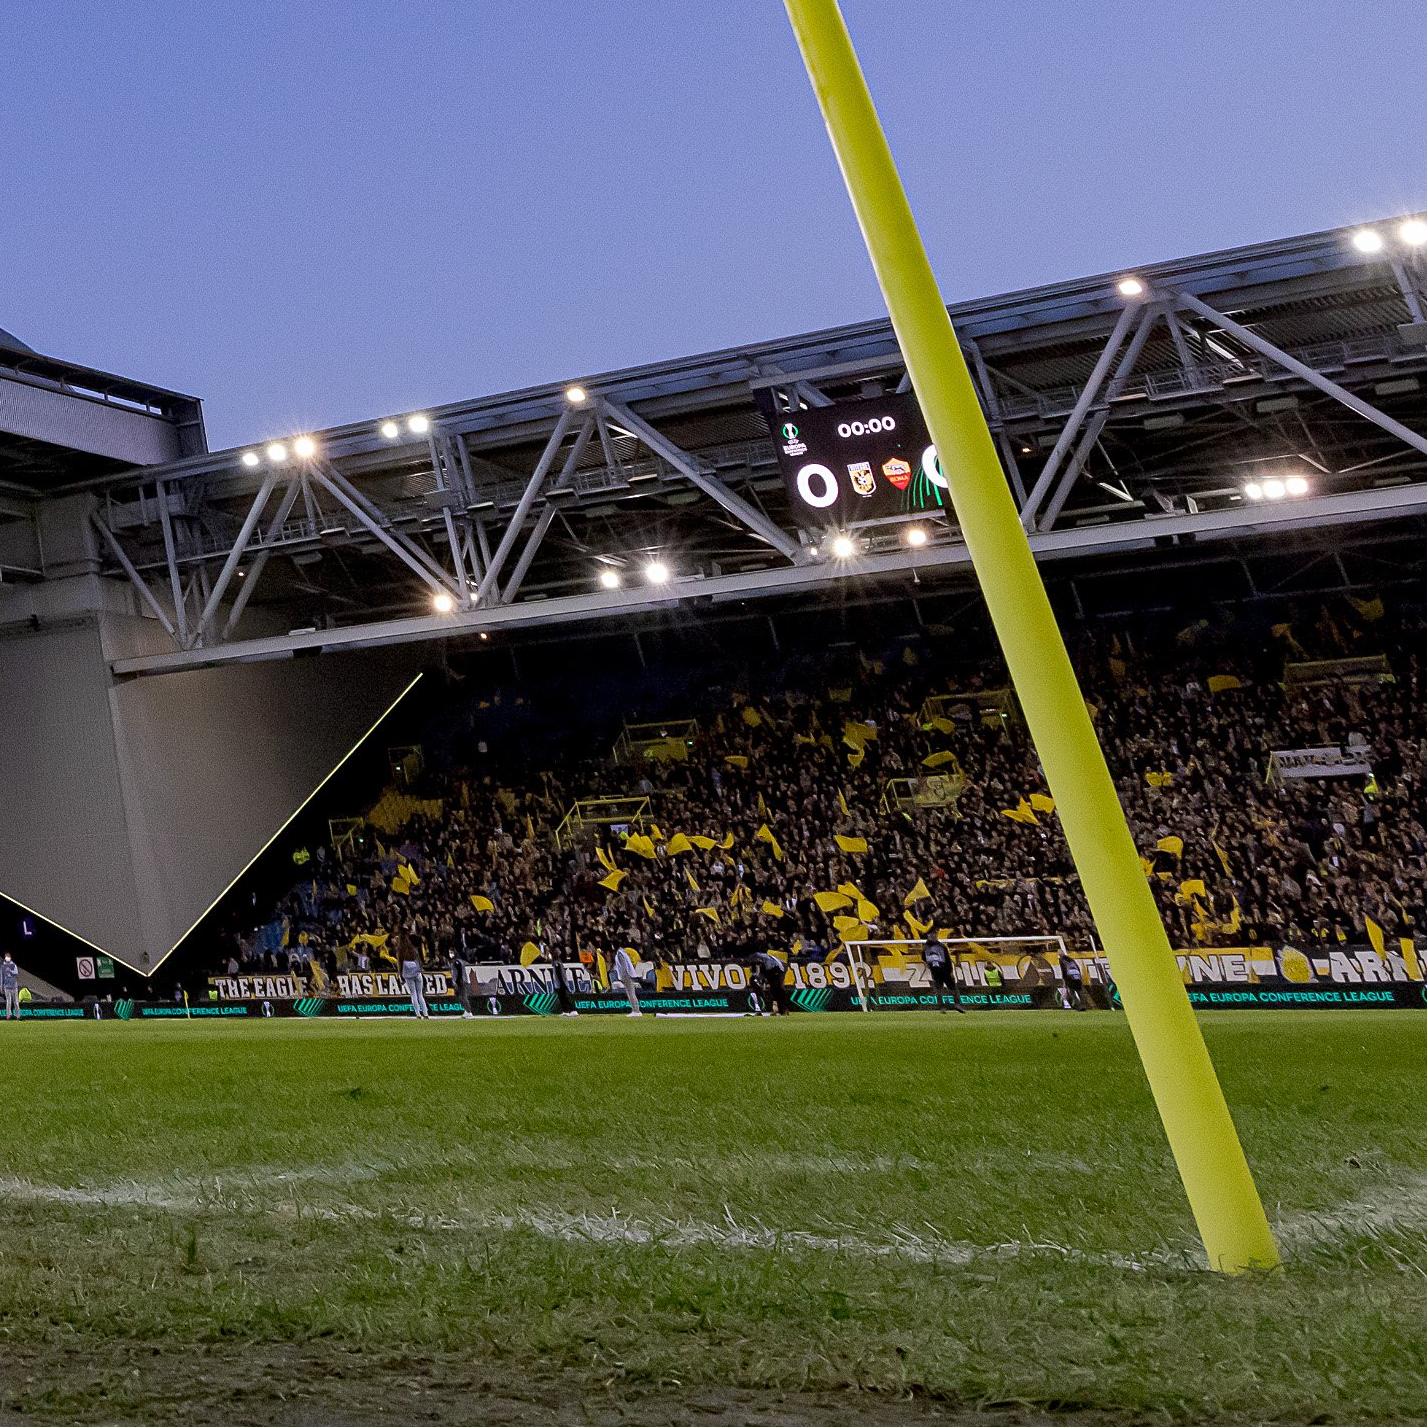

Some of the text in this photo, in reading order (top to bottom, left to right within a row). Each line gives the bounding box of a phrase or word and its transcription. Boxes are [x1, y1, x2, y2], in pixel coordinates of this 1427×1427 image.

[838, 416, 896, 438] 00:00
[797, 463, 839, 508] 0
[1329, 950, 1427, 982] ARN
[215, 978, 250, 998] THE
[253, 976, 308, 998] EAGLE
[337, 975, 374, 995] HAS
[575, 998, 728, 1009] UEFA EUROPA ONFERENCE LEAGUE
[878, 996, 918, 1005] EUROPA
[989, 994, 1032, 1004] LEAGUE
[1188, 991, 1395, 1002] EFA EUROPA CONFERENCE LEAGUE
[338, 1004, 357, 1012] UEFA
[358, 1004, 387, 1012] EUROPA
